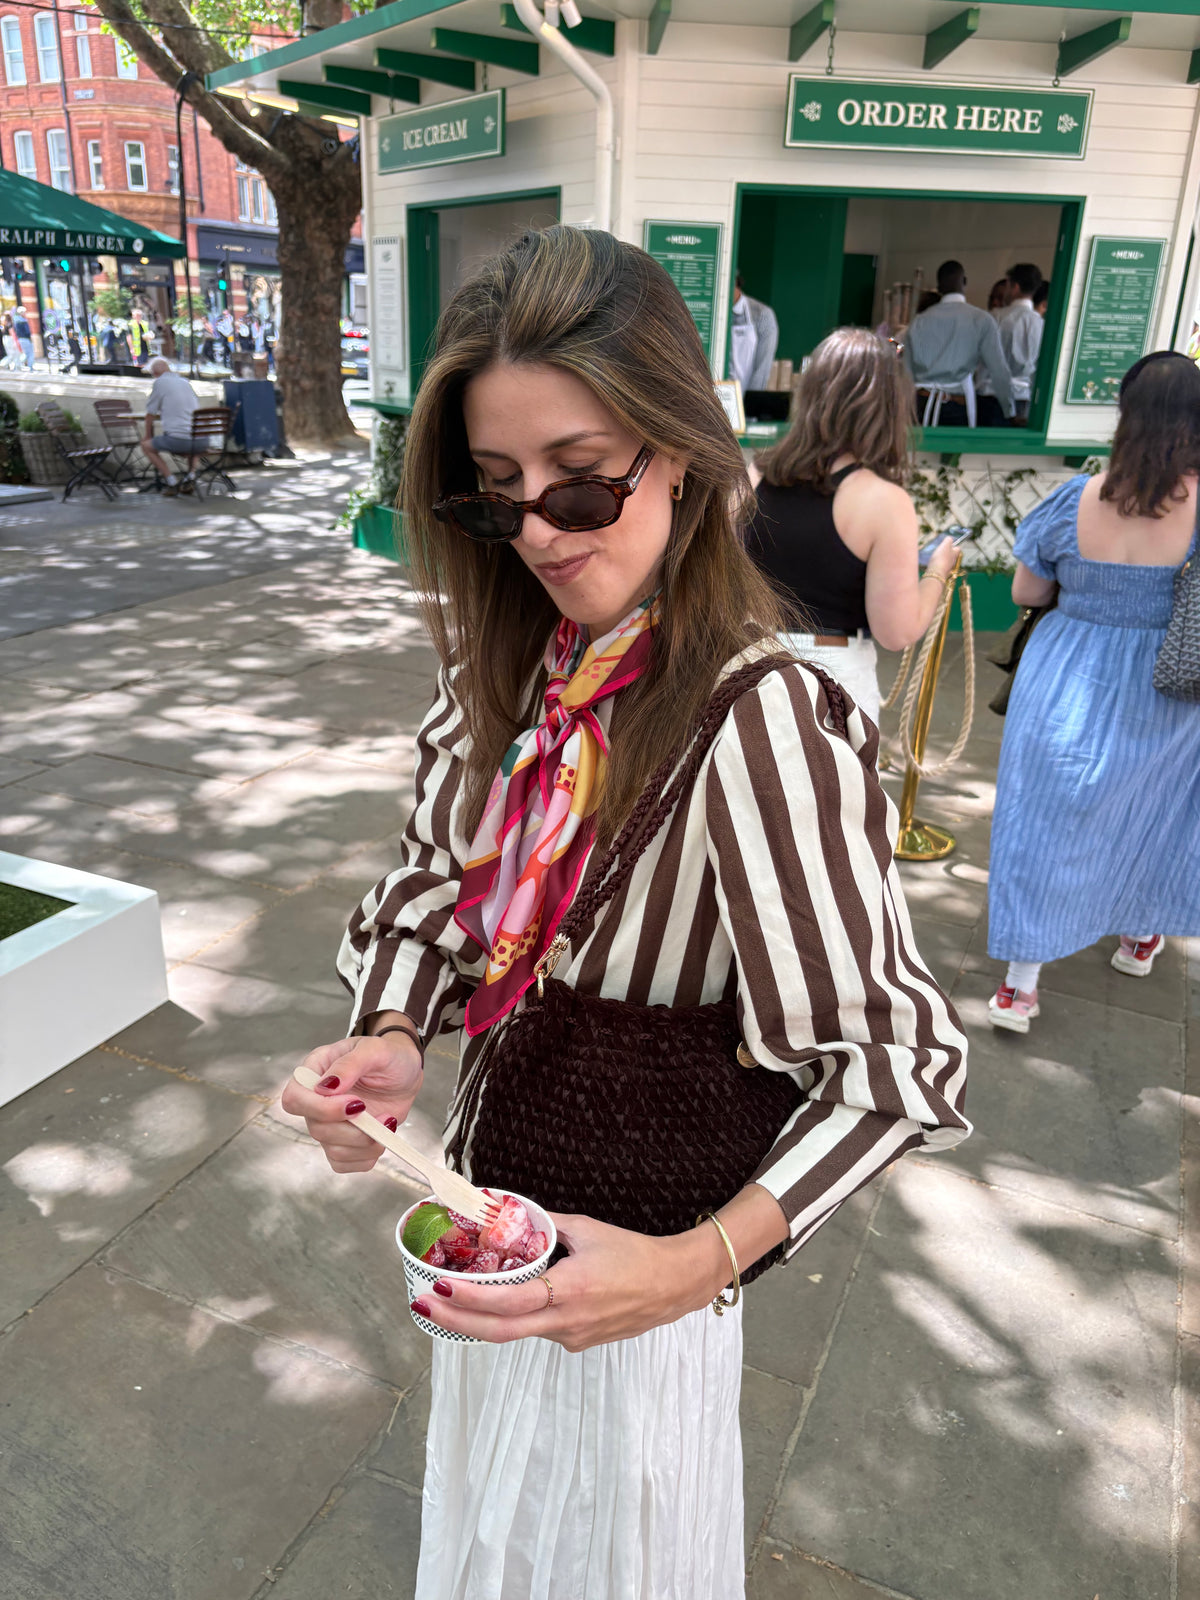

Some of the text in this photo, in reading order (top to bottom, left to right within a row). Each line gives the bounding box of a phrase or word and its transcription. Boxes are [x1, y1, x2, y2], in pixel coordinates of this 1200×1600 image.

[837, 99, 1043, 134] ORDER HERE
[402, 118, 468, 151] ICE CREAM
[0, 228, 126, 251] RALPH LAUREN
[671, 234, 697, 245] MENU
[1115, 249, 1139, 260] MENU
